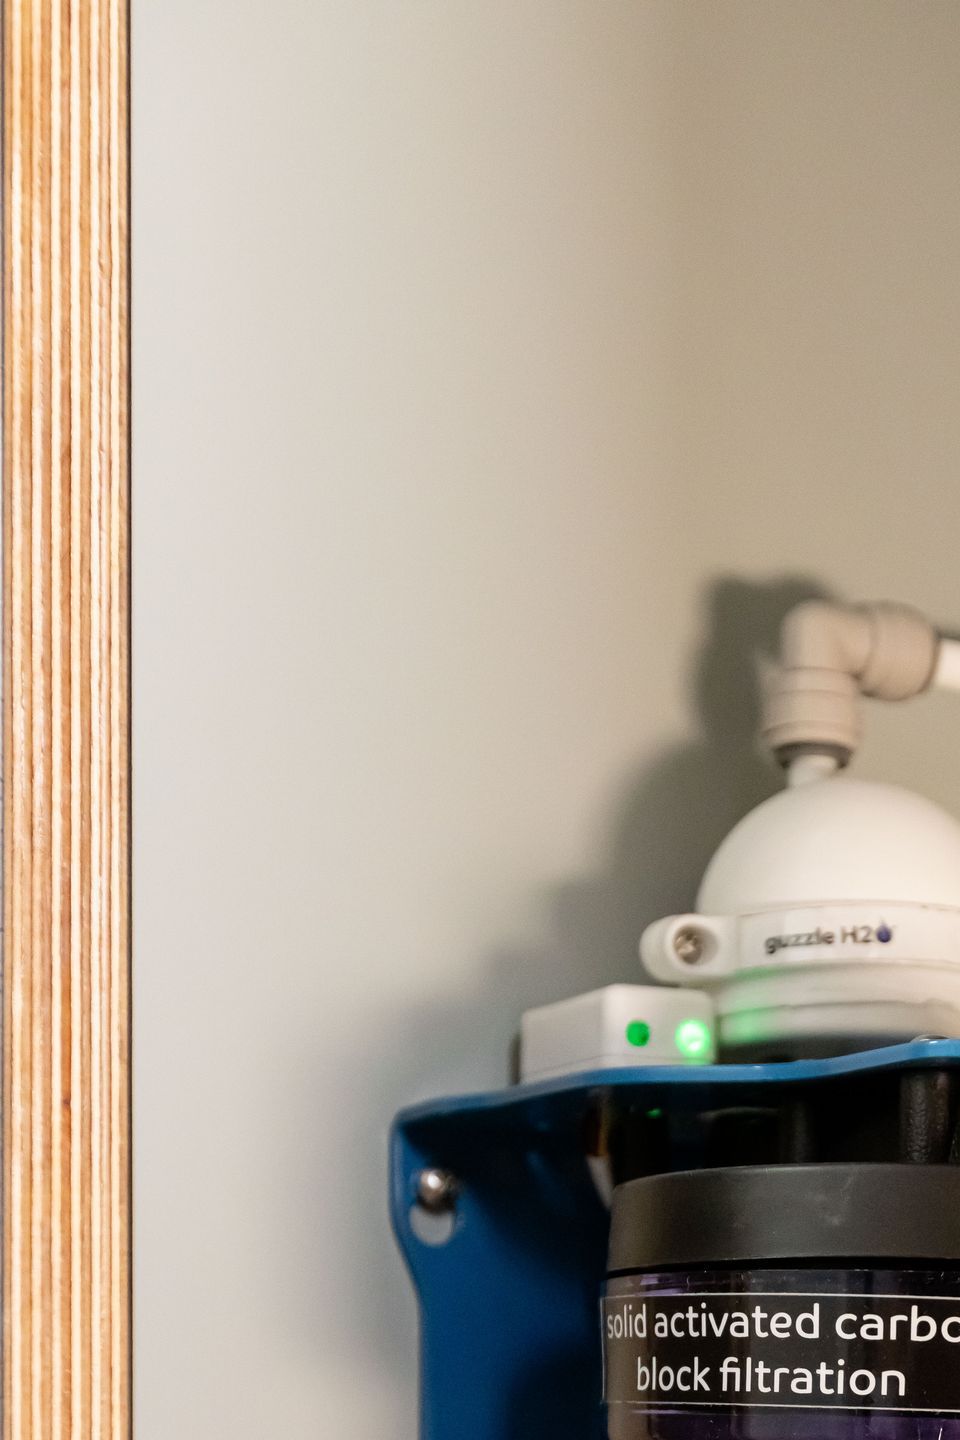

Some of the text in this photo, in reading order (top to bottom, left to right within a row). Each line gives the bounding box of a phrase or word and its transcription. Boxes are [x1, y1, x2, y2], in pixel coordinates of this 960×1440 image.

[606, 1303, 647, 1338] solid
[654, 1302, 819, 1338] activated
[637, 1356, 906, 1396] block filtration
